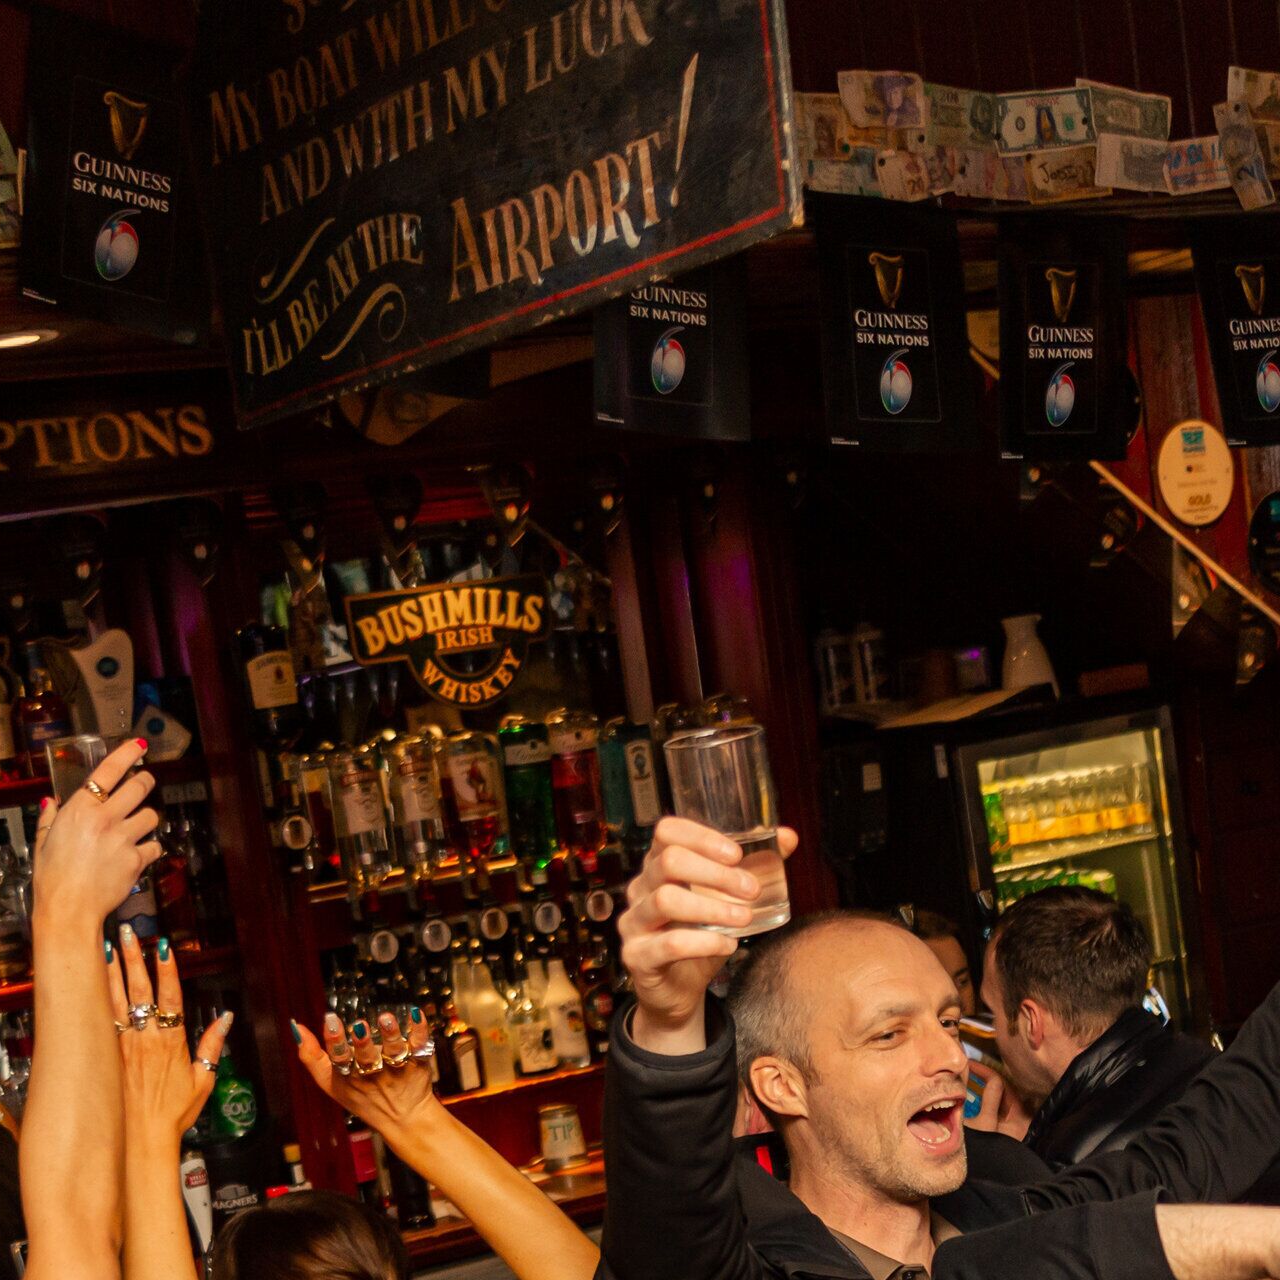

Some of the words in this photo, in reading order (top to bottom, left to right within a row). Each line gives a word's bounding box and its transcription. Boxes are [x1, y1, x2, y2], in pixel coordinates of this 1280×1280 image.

[269, 27, 360, 129] BOAT
[260, 137, 331, 224] AND
[333, 80, 436, 179] WITH
[442, 36, 512, 136] MY
[522, 0, 656, 94] LUCK
[73, 151, 171, 194] GUINNESS
[447, 52, 700, 304] AIRPORT!
[72, 177, 98, 196] SIX
[101, 184, 170, 214] NATIONS
[286, 277, 330, 354] BE
[322, 222, 367, 311] AT
[355, 211, 423, 280] THE
[629, 285, 708, 309] GUINNESS
[629, 304, 650, 321] SIX
[650, 306, 708, 329] NATIONS
[854, 307, 930, 331] GUINNESS
[856, 332, 875, 345] SIX
[877, 333, 930, 348] NATIONS
[1027, 323, 1095, 344] GUINNESS
[1232, 338, 1249, 352] SIX
[1028, 346, 1046, 360] SIX
[1046, 347, 1094, 360] NATIONS
[355, 587, 545, 656] BUSHMILLS
[435, 626, 496, 650] IRISH
[422, 646, 521, 704] WHISKEY
